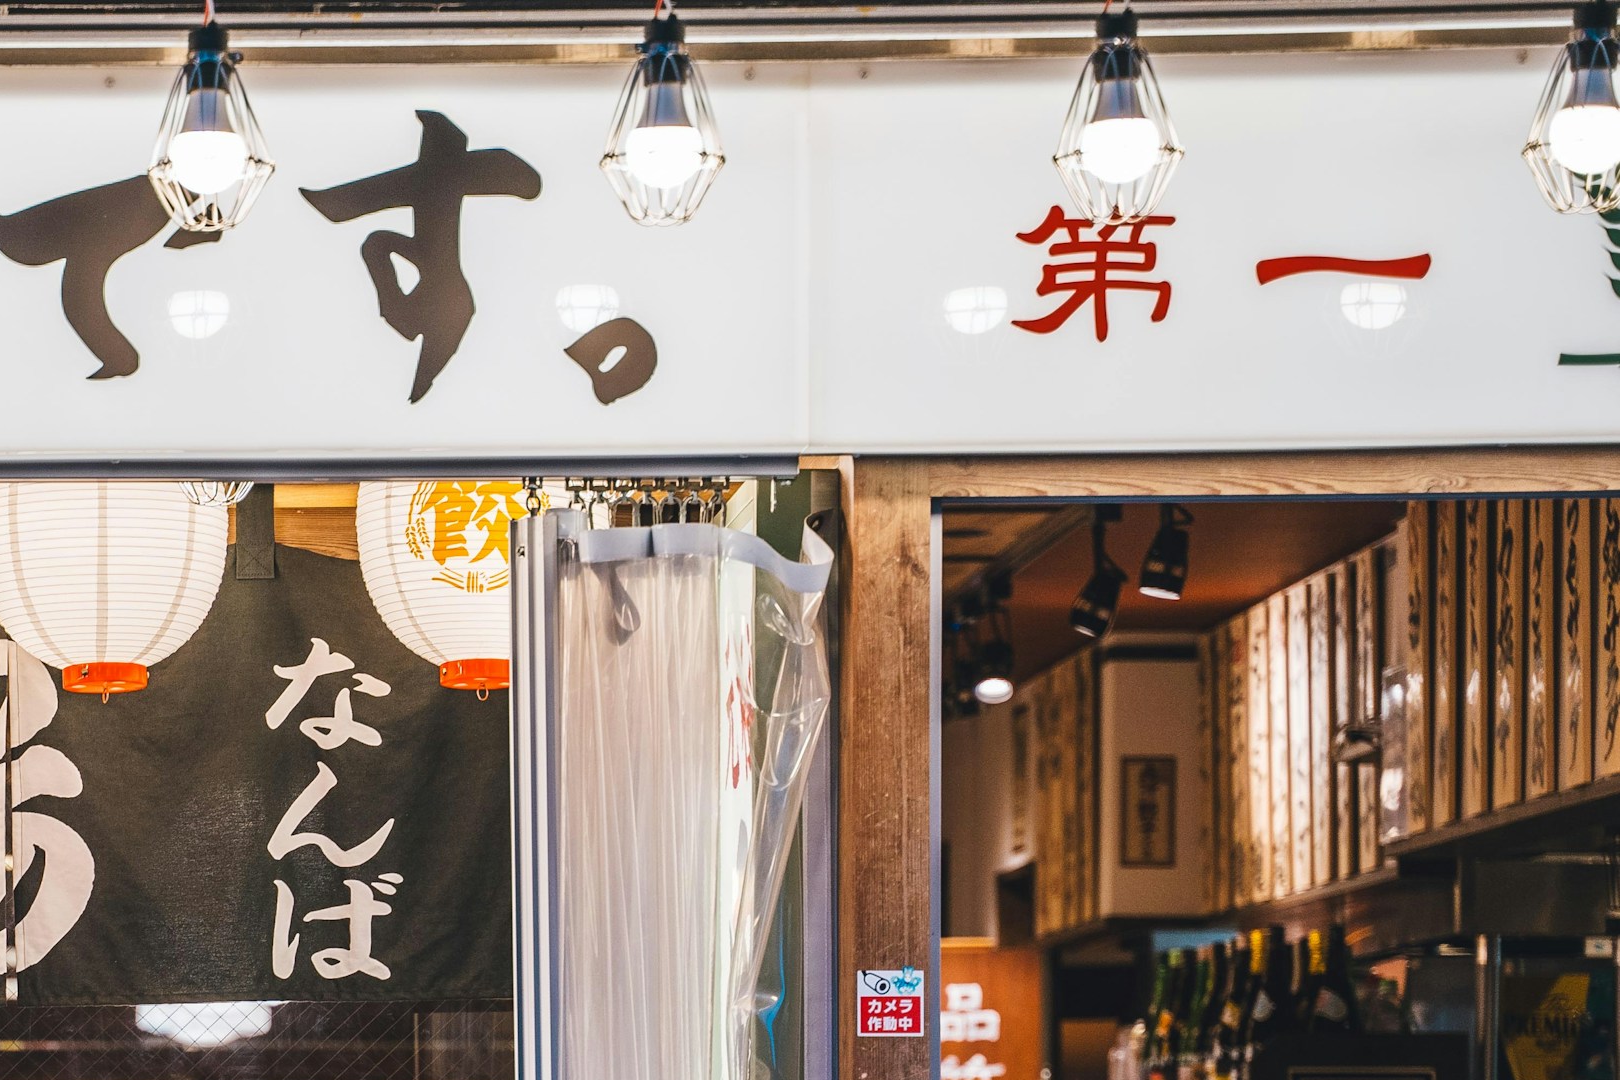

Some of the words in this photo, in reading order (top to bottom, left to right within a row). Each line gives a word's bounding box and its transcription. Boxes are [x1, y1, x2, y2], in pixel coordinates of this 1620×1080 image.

[265, 637, 404, 982] なんば
[867, 999, 914, 1014] カメラ
[867, 1016, 913, 1031] 作動中
